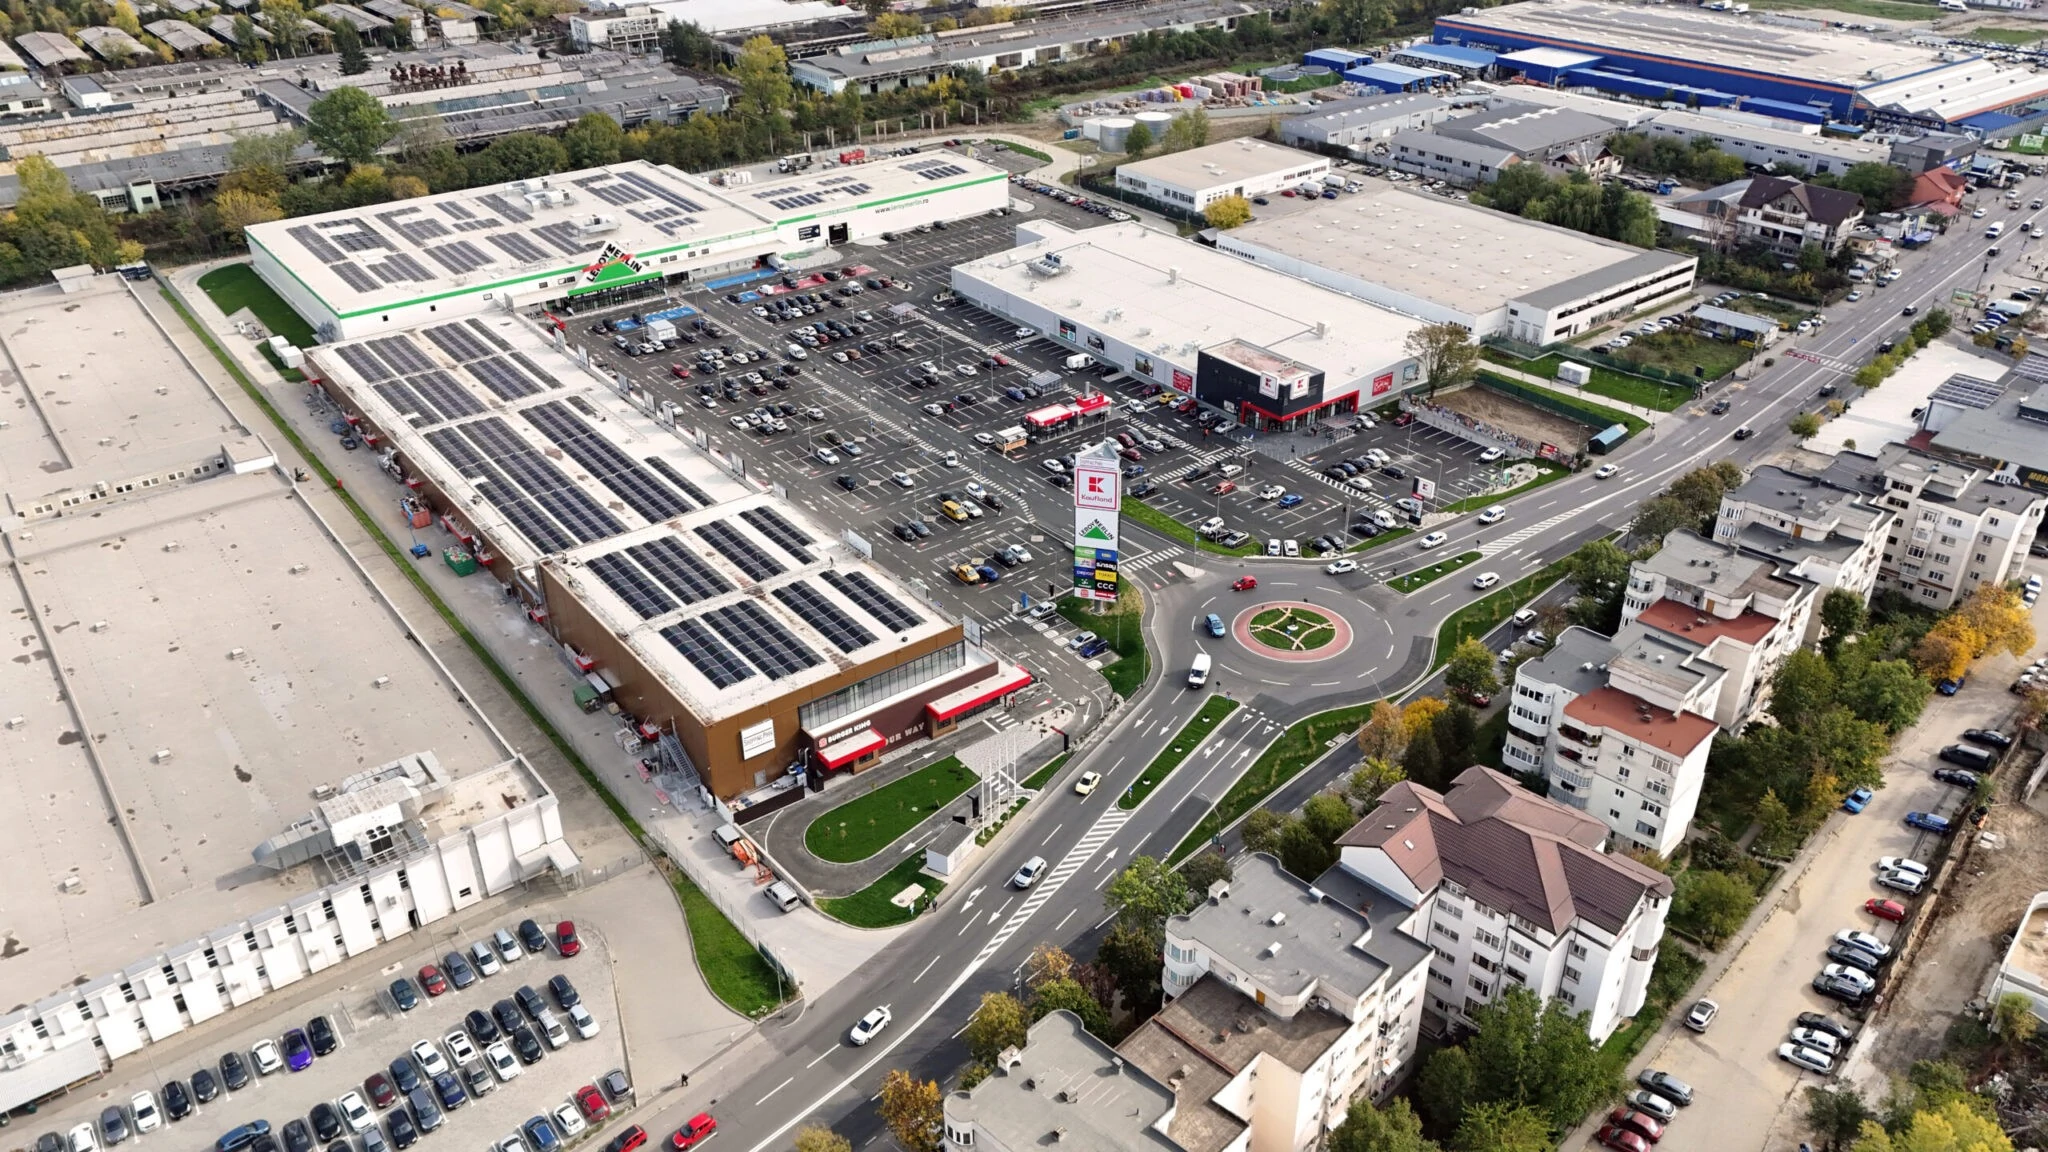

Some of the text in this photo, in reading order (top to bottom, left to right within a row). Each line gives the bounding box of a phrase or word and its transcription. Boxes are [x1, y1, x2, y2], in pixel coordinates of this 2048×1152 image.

[586, 250, 610, 282] LEOY
[1081, 494, 1113, 503] Kaufland
[1097, 582, 1115, 590] CCC
[828, 727, 853, 743] BURGER
[853, 719, 872, 732] KING
[904, 722, 925, 737] WAY
